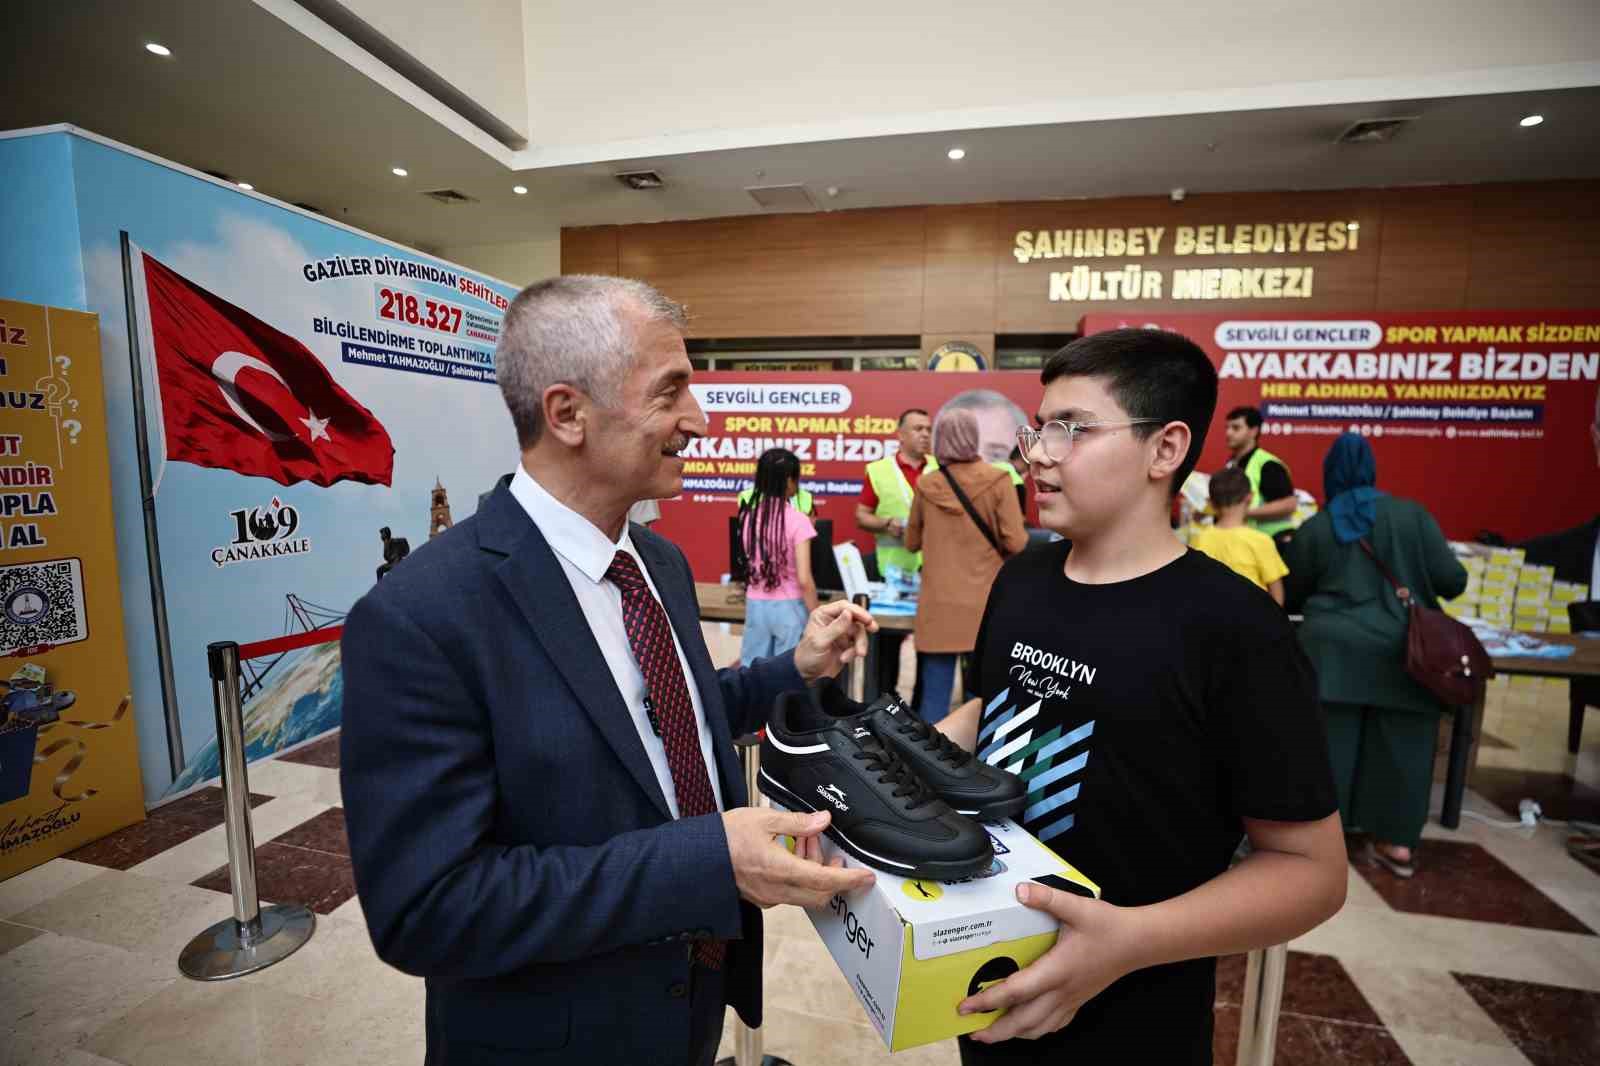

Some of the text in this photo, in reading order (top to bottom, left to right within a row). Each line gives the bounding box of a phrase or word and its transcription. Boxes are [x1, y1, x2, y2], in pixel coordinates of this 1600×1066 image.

[1014, 221, 1360, 263] ŞAHİNBEY BELEDİYESİ
[303, 256, 509, 311] GAZİLER DİYARINDAN ŞEHİTLER
[1049, 264, 1163, 301] KÜLTÜR
[380, 288, 462, 334] 218.327
[313, 316, 492, 364] BİLGİLENDİRME TOPLANTIMIZA
[1226, 326, 1371, 343] SEVGİLİ GENÇLER
[1386, 322, 1600, 343] SPOR YAPMAK SİZDEN
[348, 346, 387, 363] Mehmet
[1218, 347, 1599, 380] AYAKKABINIZ BİZDEN
[706, 387, 841, 407] SEVGİLİ GENÇLER
[1261, 384, 1546, 399] HER ADIMDA YANINIZDAYIZ
[725, 416, 772, 433] SPOR
[774, 417, 851, 434] YAPMAK
[0, 493, 55, 516] PLA
[10, 525, 44, 547] AL
[211, 539, 309, 567] ÇANAKKALE
[1010, 641, 1097, 685] BROOKLYN
[1009, 664, 1038, 687] New
[1040, 676, 1071, 700] York
[816, 785, 849, 812] Slazenger
